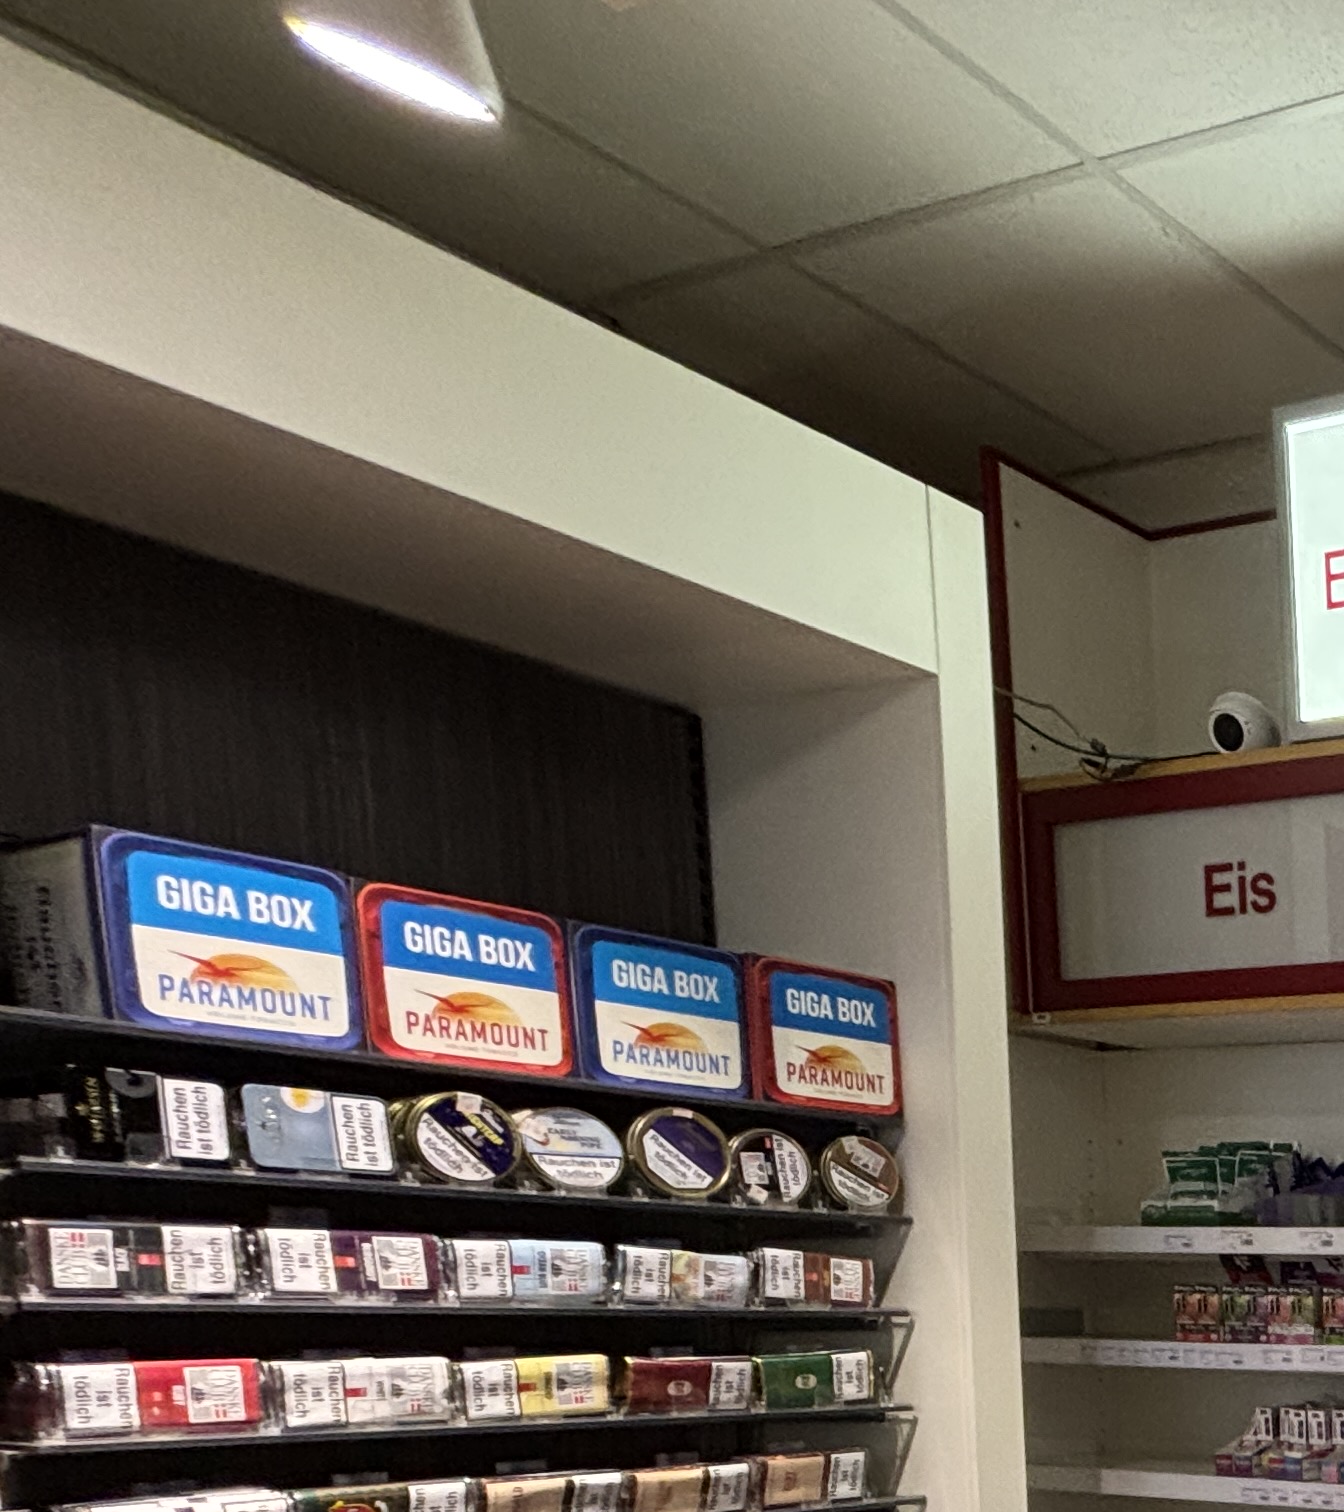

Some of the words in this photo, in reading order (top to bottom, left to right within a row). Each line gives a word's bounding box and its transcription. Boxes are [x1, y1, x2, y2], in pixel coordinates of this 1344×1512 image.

[156, 874, 240, 921] GIGA
[248, 890, 316, 933] BOX
[1203, 861, 1277, 918] Eis
[403, 920, 473, 961] GIGA
[478, 934, 535, 972] BOX
[158, 973, 332, 1022] PARAMOUNT
[612, 959, 669, 995] GIGA
[674, 970, 721, 1004] BOX
[406, 1010, 549, 1052] PARAMOUNT
[785, 987, 834, 1021] GIGA
[837, 996, 876, 1028] BOX
[612, 1039, 731, 1077] PARAMOUNT
[786, 1062, 886, 1095] PARAMOUNT
[175, 1086, 188, 1158] Rauchen
[342, 1104, 359, 1163] Rauchen
[538, 1156, 597, 1169] Rauchen
[168, 1230, 185, 1291] Rauchen
[211, 1237, 225, 1285] tödlich
[280, 1237, 296, 1285] tödlich
[313, 1233, 331, 1291] Rauchen
[464, 1248, 478, 1291] tödlich
[495, 1244, 508, 1297] Rauchen
[632, 1255, 642, 1295] tödlich
[657, 1253, 670, 1302] Rauchen
[72, 1375, 92, 1425] tödlich
[114, 1367, 133, 1430] Rauchen
[471, 1369, 487, 1413] tödlich
[502, 1363, 515, 1418] Rauchen
